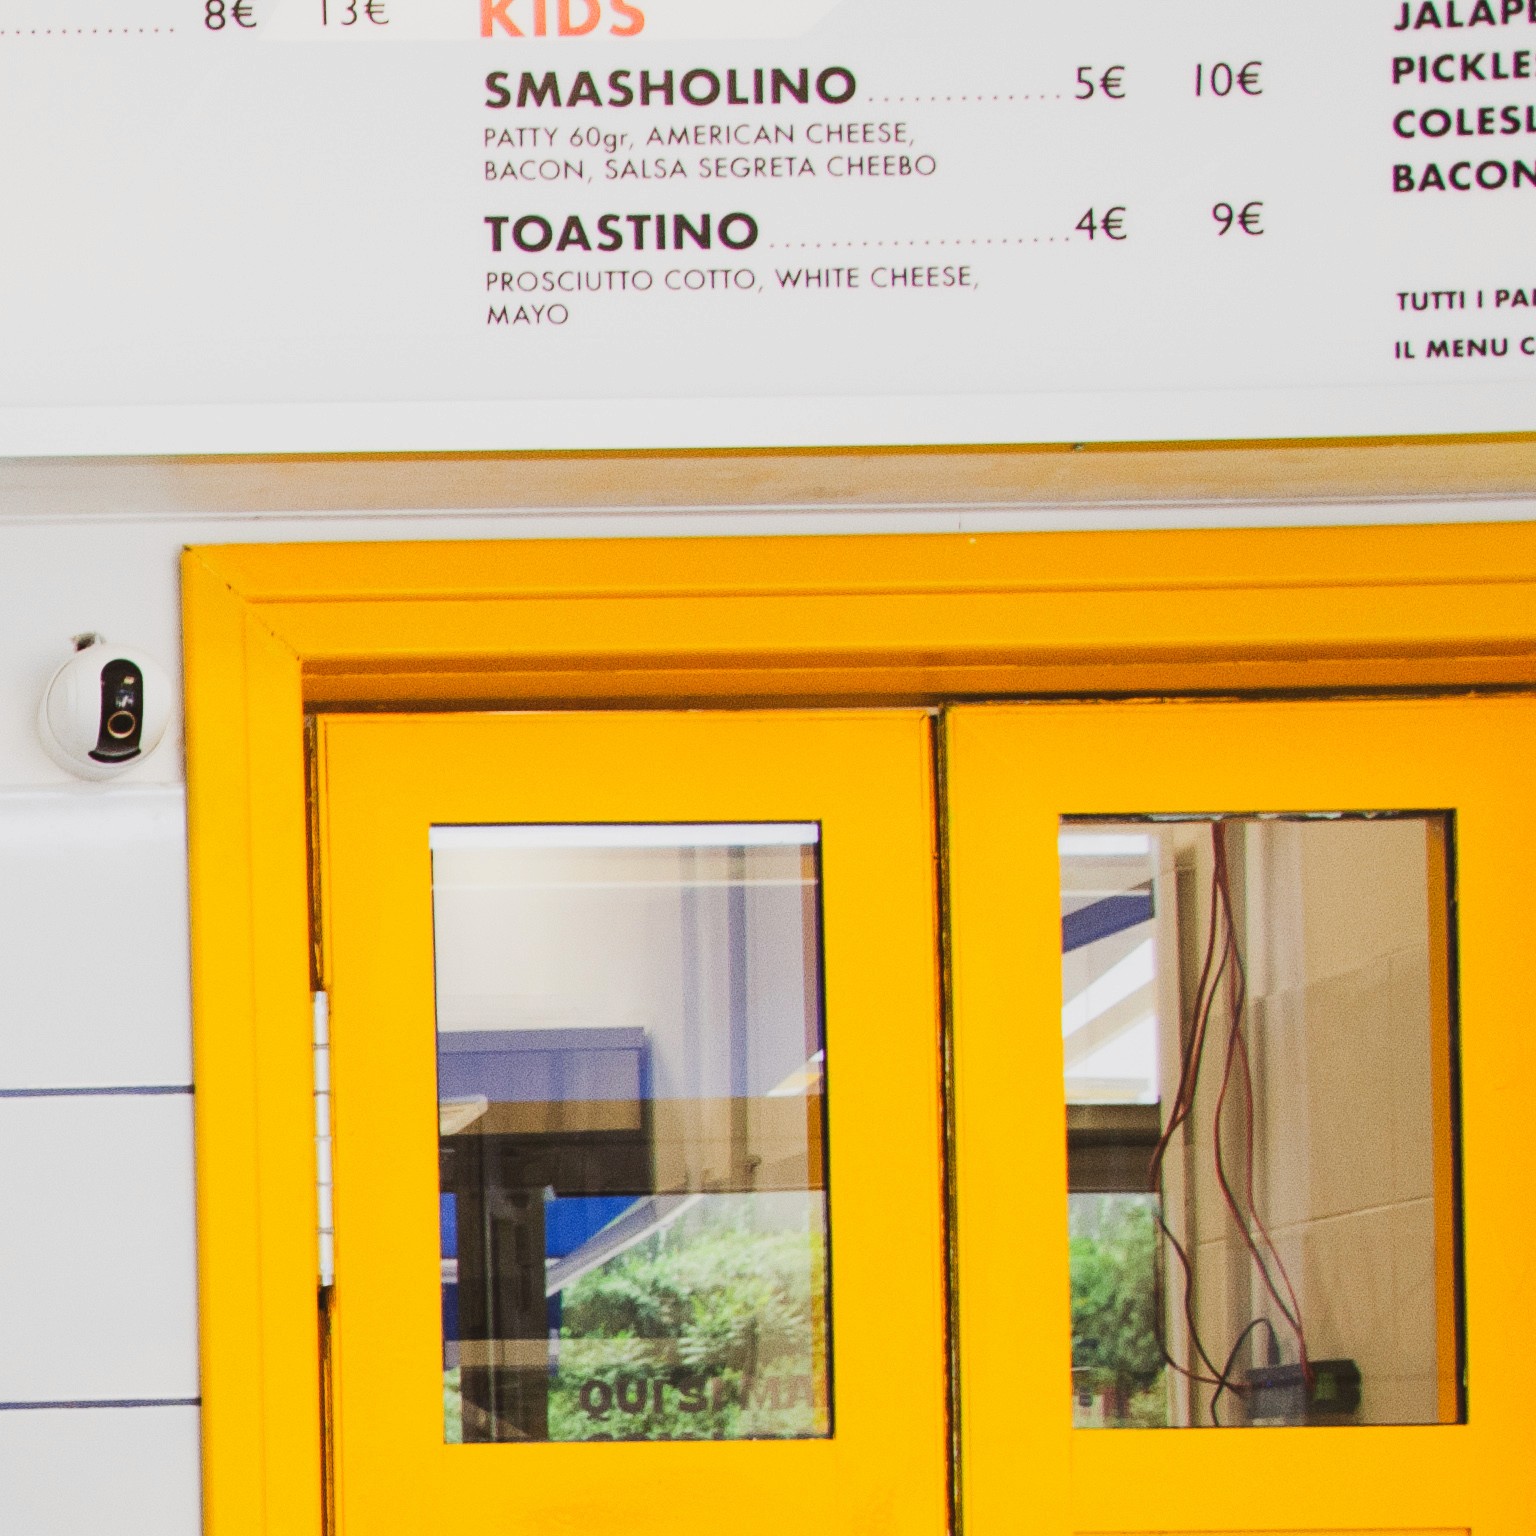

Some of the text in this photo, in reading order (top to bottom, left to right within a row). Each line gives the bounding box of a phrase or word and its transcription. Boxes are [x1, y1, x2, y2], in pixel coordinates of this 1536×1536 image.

[480, 0, 645, 37] KIDS
[1393, 51, 1536, 84] PICKLE
[485, 61, 1262, 109] SMASHOLINO 5€ 10€
[484, 122, 914, 153] PATTY 60gr, AMERICAN CHEESE,
[485, 155, 936, 184] BACON, SALSA SEGRETA CHEEBO
[484, 201, 1264, 253] TOASTINO 4€ 9€
[486, 266, 979, 292] PROSCIUTTO COTTO, WHITE CHEESE,
[487, 304, 568, 324] MAYO
[1396, 287, 1536, 311] TUTTI I PA
[1394, 341, 1415, 359] IL
[1426, 338, 1508, 358] MENU
